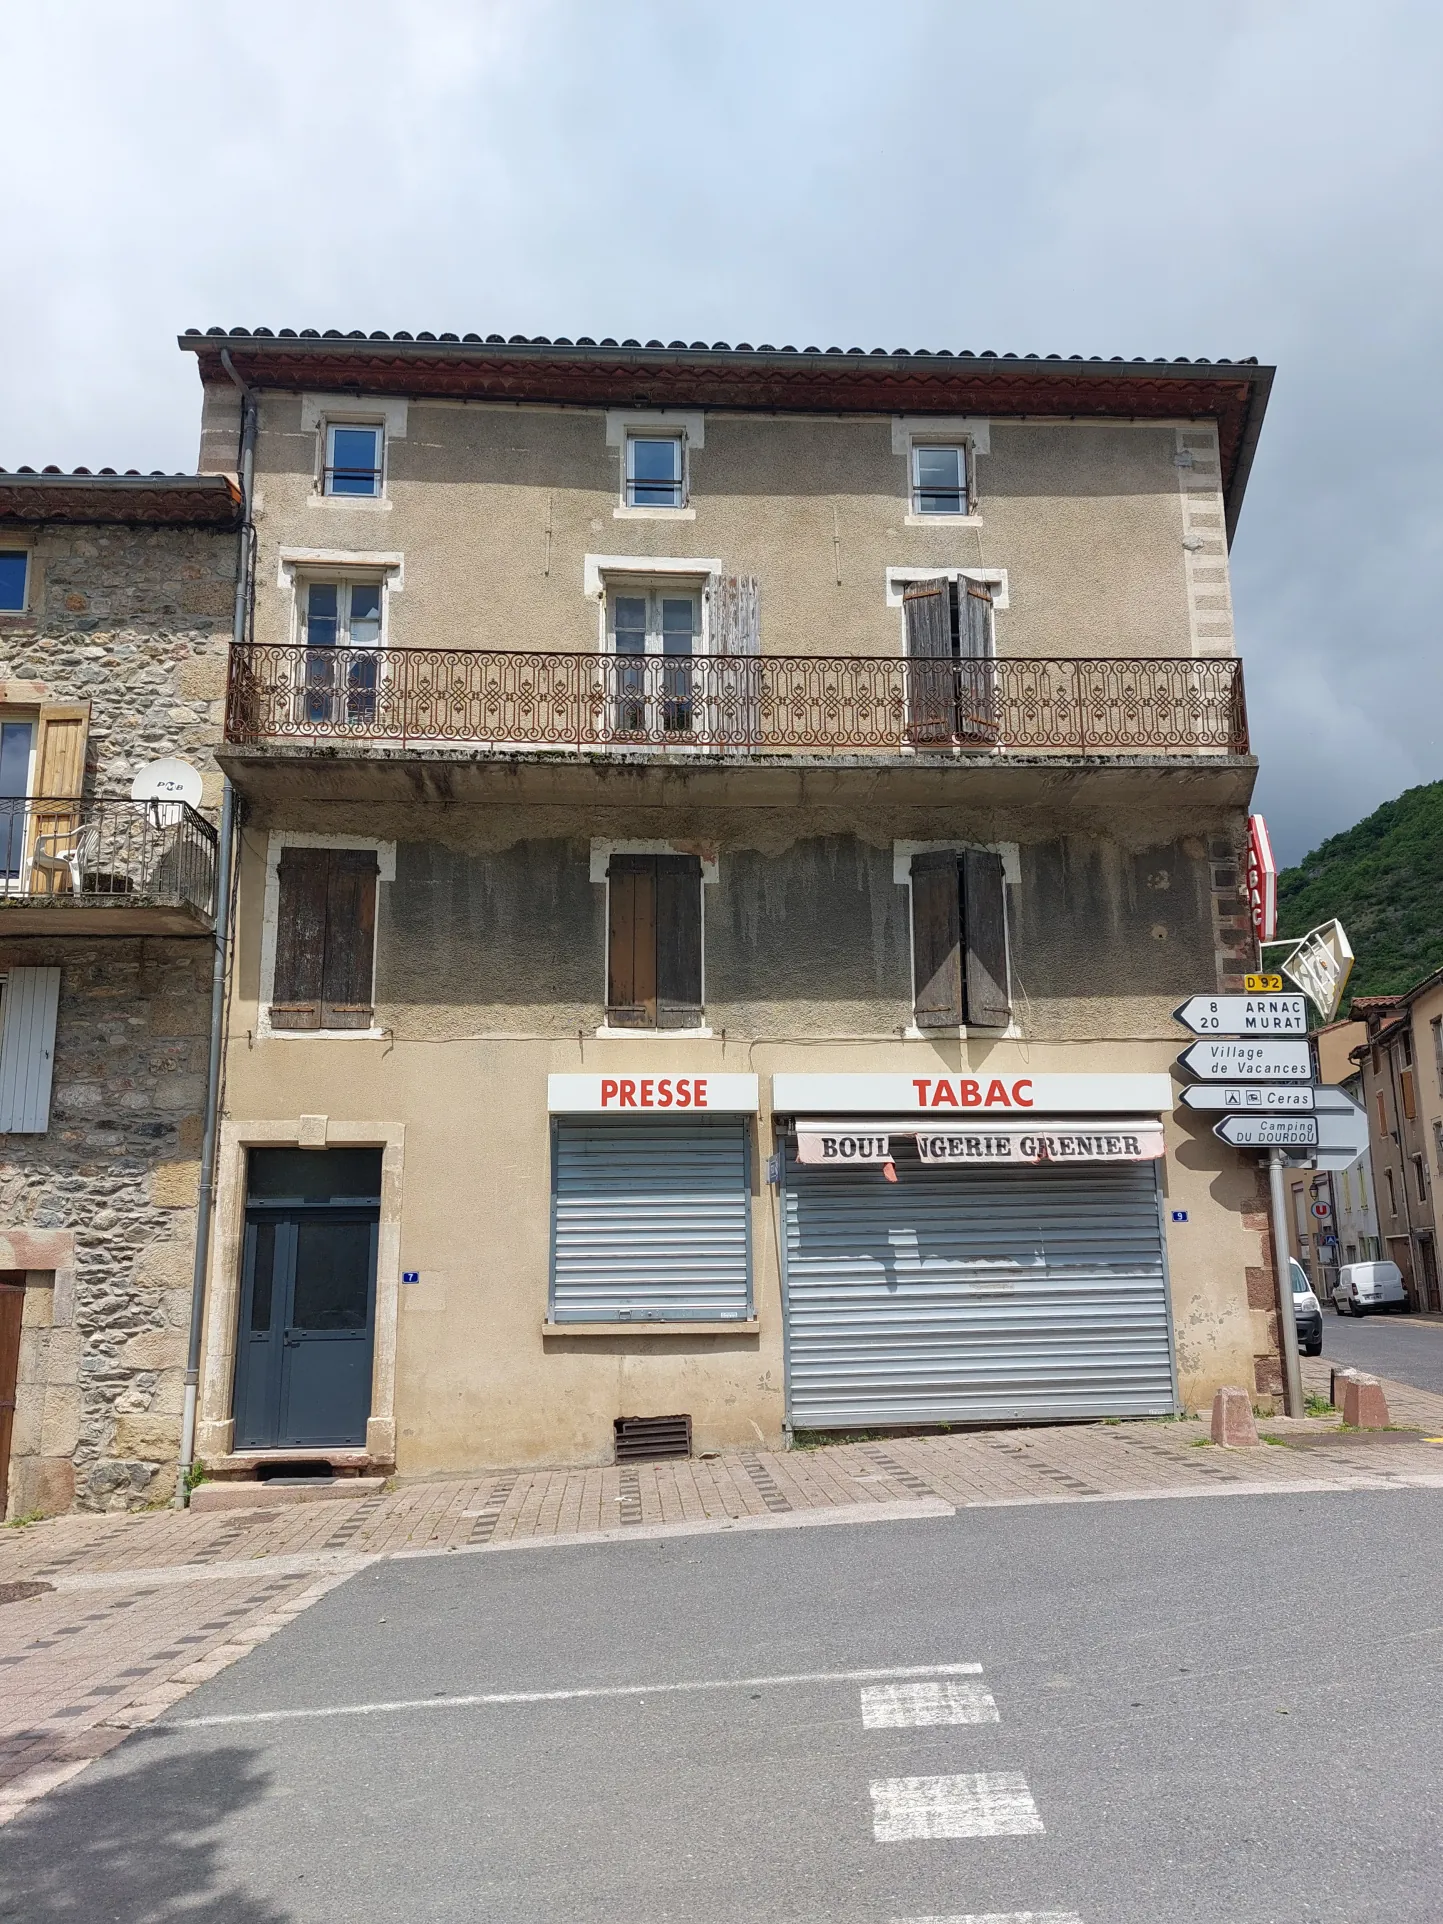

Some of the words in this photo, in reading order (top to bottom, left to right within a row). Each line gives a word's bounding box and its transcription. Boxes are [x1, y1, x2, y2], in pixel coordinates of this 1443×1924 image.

[1247, 830, 1262, 926] TABAC
[1247, 977, 1256, 988] D
[1261, 977, 1280, 988] 92
[1209, 1002, 1218, 1013] 8
[1246, 1002, 1301, 1013] ARNAC
[1200, 1017, 1220, 1028] 20
[1245, 1017, 1301, 1028] MURAT
[1211, 1046, 1264, 1060] Village
[1211, 1062, 1228, 1074] de
[1238, 1062, 1306, 1074] Vacances
[601, 1079, 708, 1107] PRESSE
[912, 1079, 1034, 1107] TABAC
[1267, 1092, 1308, 1104] Ceras
[1260, 1121, 1313, 1134] Camping
[1236, 1132, 1252, 1142] DU
[1258, 1132, 1314, 1143] DOURDOU
[822, 1137, 1011, 1158] BOULNGERIE
[1019, 1136, 1142, 1157] GRENIER
[1177, 1212, 1183, 1221] 9
[408, 1273, 414, 1282] 7
